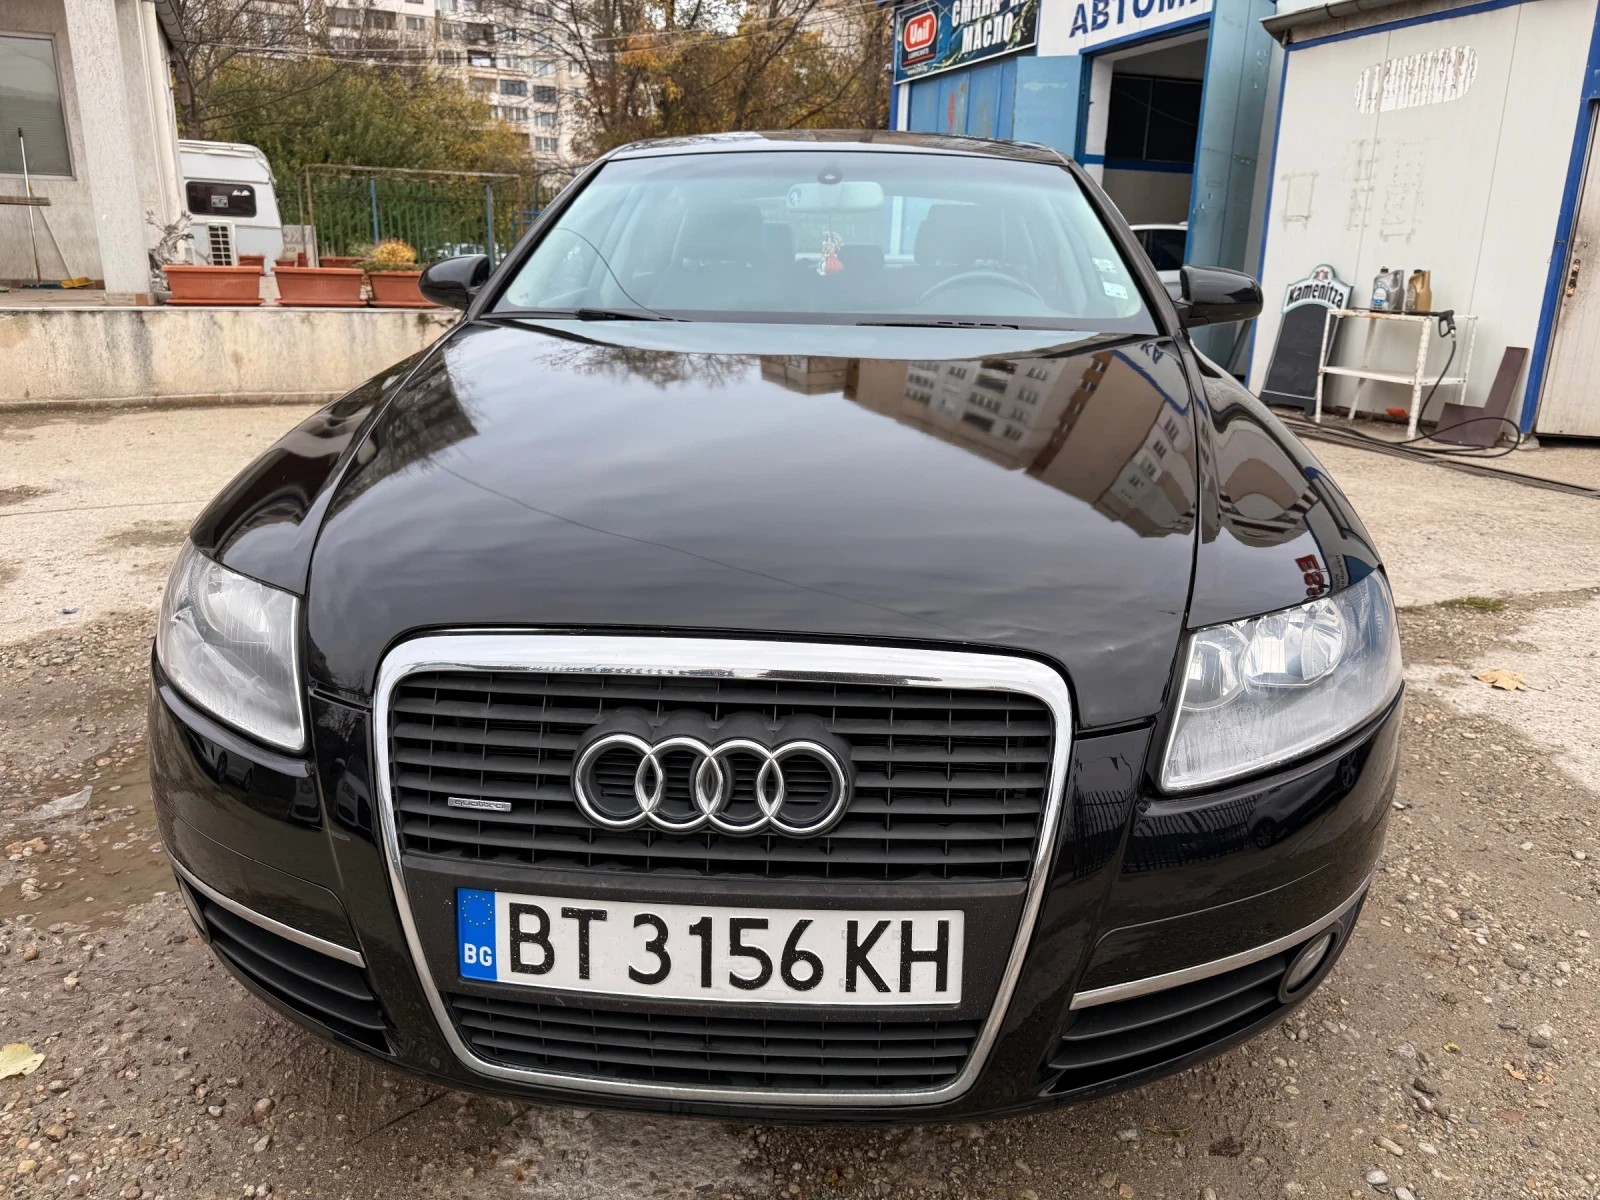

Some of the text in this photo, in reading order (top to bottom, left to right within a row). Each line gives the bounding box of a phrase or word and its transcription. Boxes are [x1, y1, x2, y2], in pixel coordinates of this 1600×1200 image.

[910, 18, 930, 45] Unil
[961, 12, 1014, 54] МАСЛО
[1069, 0, 1197, 38] АВТО
[1285, 280, 1344, 309] Kamenitza
[454, 799, 504, 809] quattro
[464, 943, 493, 967] BG
[627, 913, 824, 992] 3156
